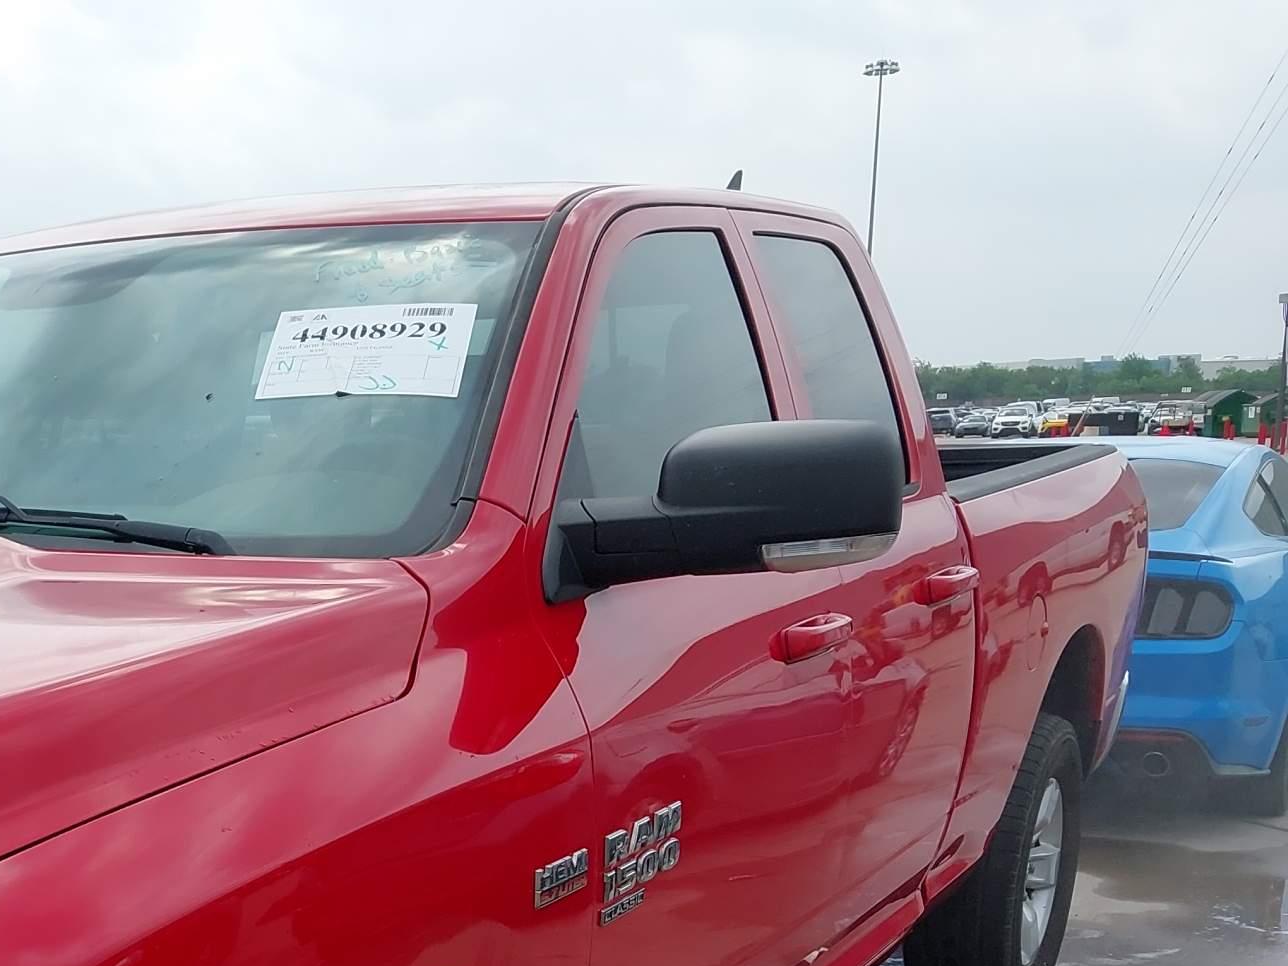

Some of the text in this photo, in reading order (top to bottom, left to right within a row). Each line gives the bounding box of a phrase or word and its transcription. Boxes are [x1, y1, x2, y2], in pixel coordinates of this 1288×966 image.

[292, 322, 448, 343] 44908929
[605, 800, 682, 868] RAM
[603, 836, 681, 904] 1500
[603, 890, 646, 925] CLASSIC
